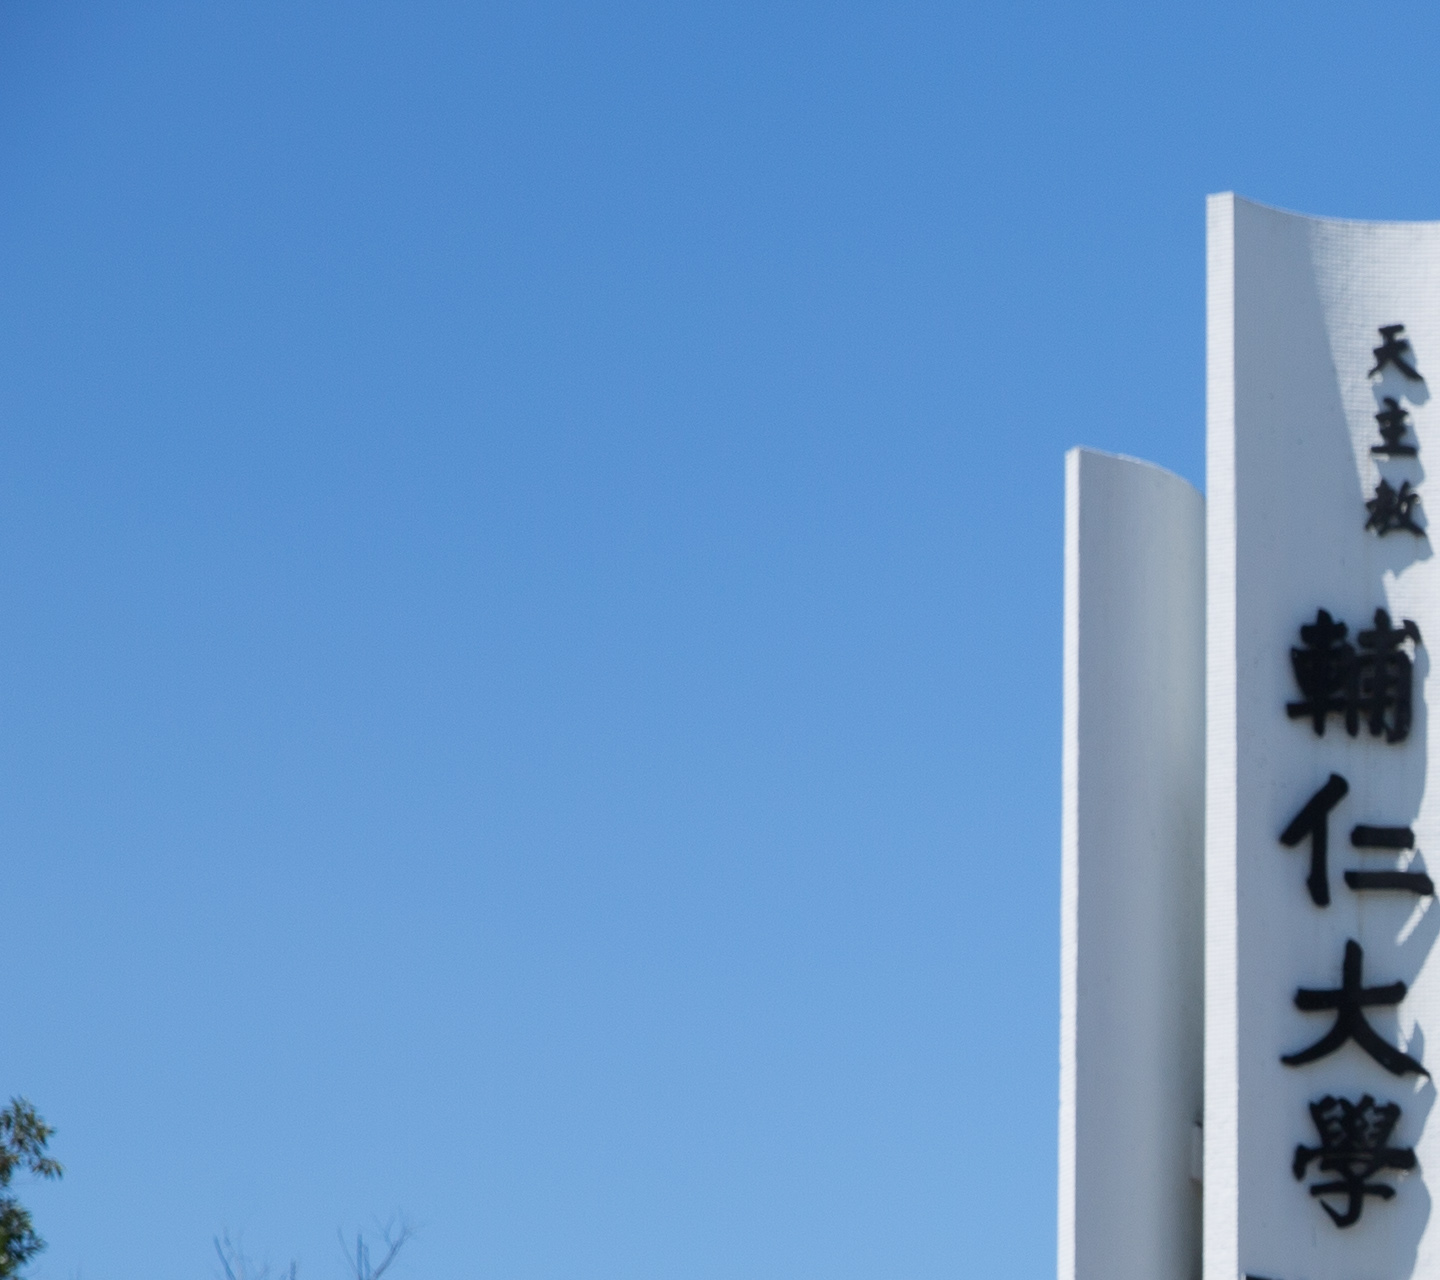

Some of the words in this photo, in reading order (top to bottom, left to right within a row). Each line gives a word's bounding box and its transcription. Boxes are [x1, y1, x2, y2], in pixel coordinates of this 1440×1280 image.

[1364, 324, 1426, 537] 天主教
[1278, 607, 1434, 1229] 輔仁大學
